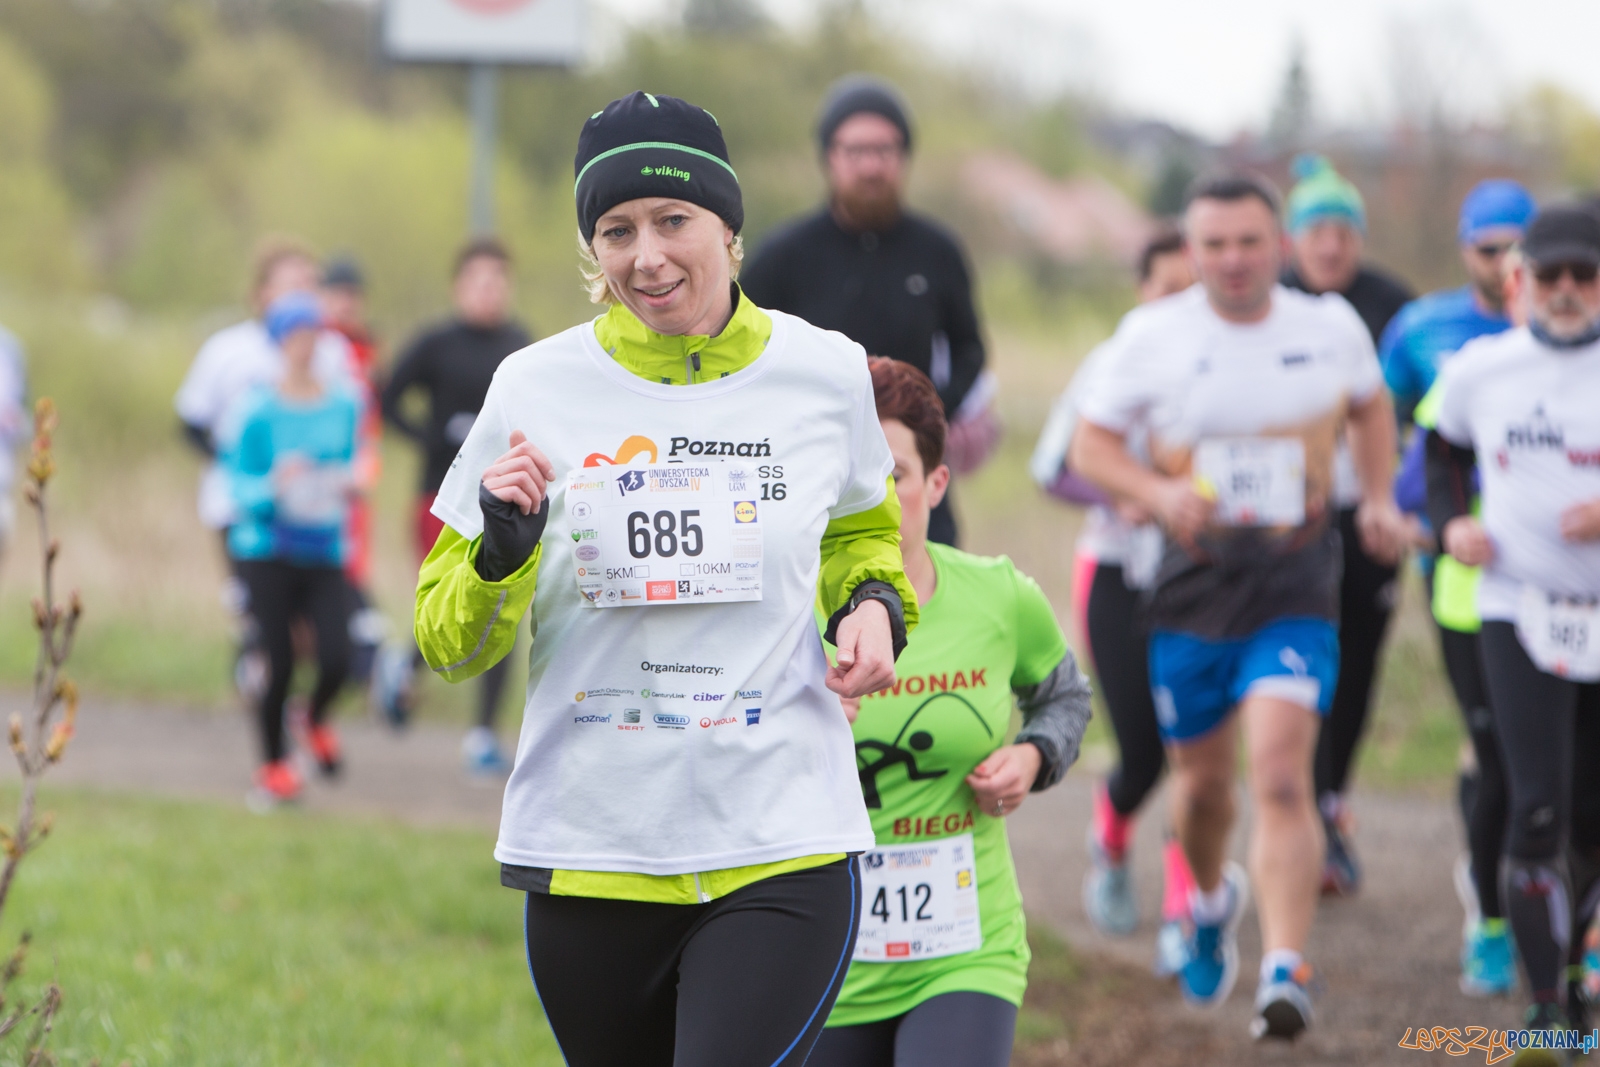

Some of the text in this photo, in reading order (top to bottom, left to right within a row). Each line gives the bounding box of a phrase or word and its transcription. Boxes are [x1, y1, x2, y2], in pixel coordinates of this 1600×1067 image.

[655, 165, 690, 181] viking
[668, 436, 771, 457] Poznań
[648, 468, 710, 478] UNIWERSYTECKA
[650, 477, 701, 491] ZADYSZKA IV
[760, 482, 787, 501] 16
[627, 509, 703, 559] 685
[606, 567, 633, 580] 5KM
[696, 563, 731, 575] 10KM
[641, 661, 724, 676] Organizatorzy:
[651, 691, 685, 699] CenturyLink
[693, 692, 725, 701] ciber
[893, 810, 974, 836] BIEGA
[871, 883, 932, 923] 412
